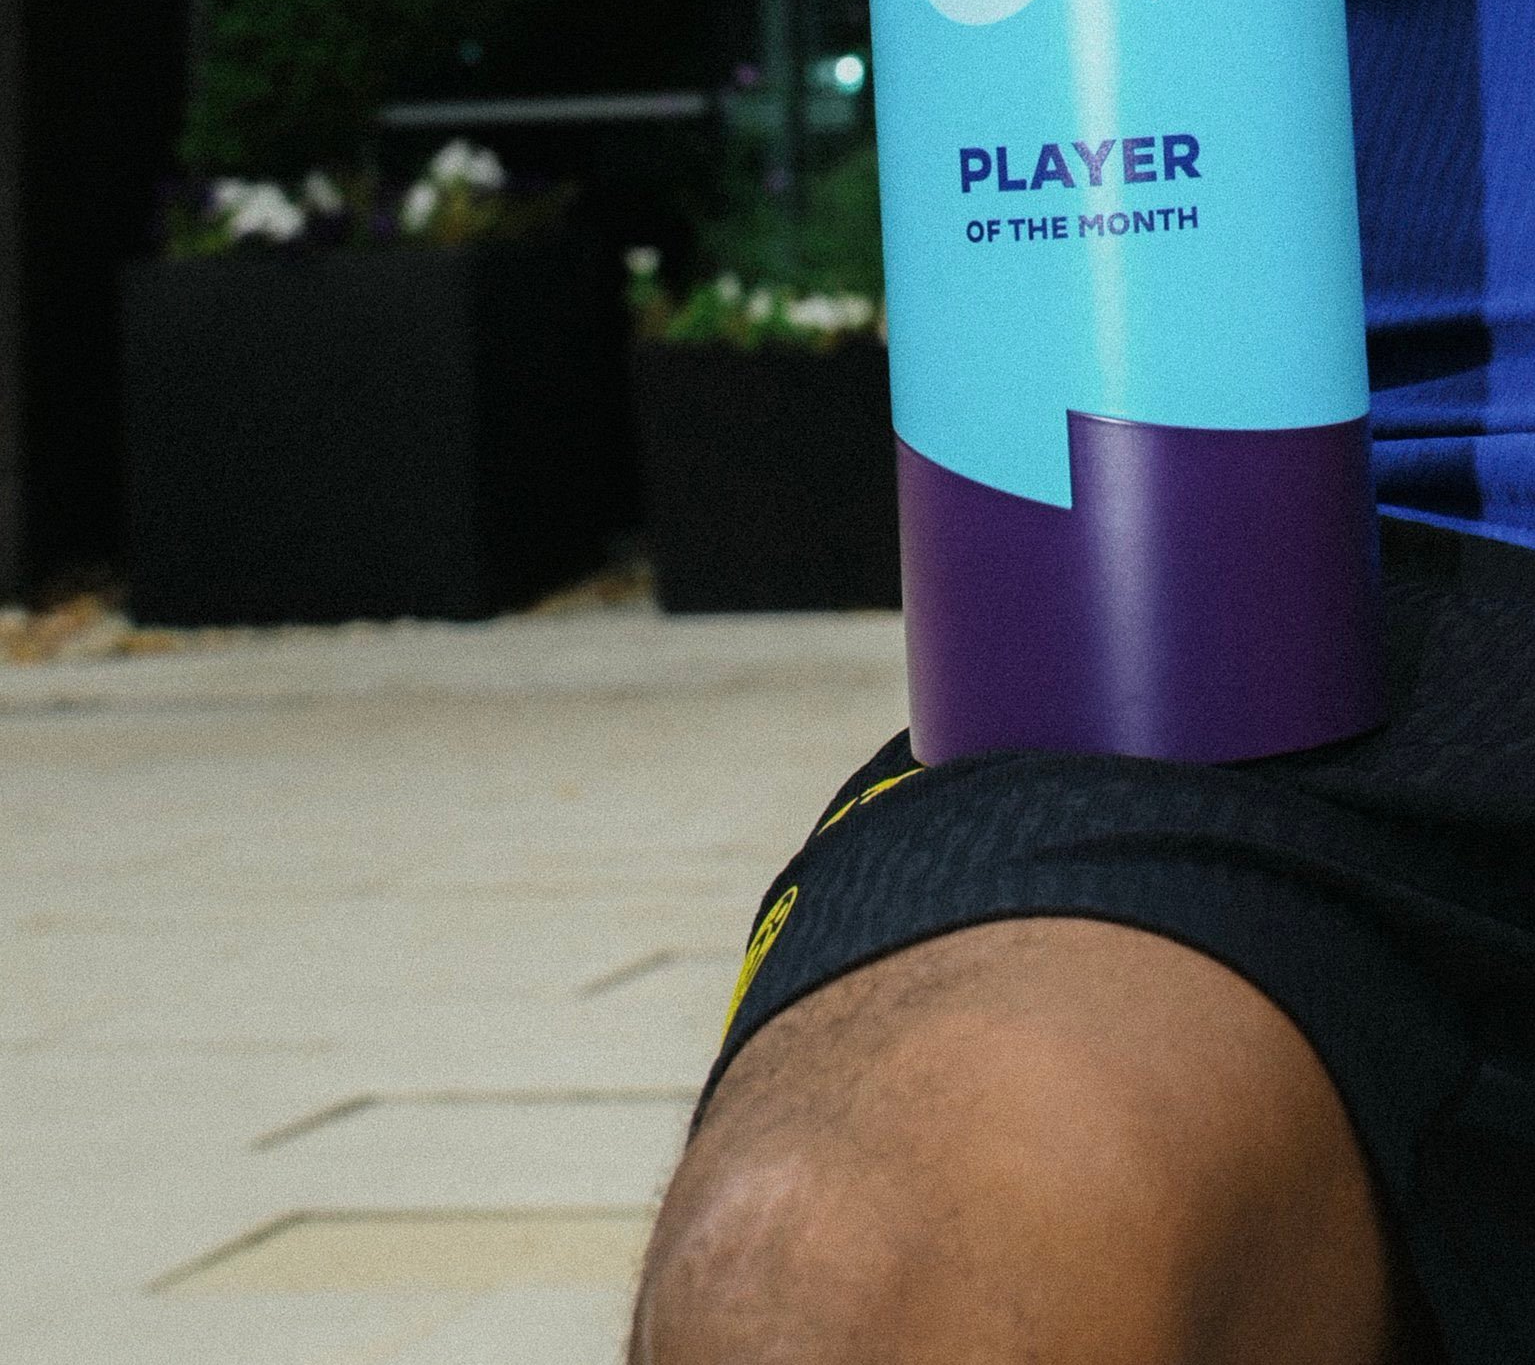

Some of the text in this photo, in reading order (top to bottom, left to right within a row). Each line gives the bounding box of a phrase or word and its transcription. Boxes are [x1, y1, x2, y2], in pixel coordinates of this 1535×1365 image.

[959, 132, 1202, 194] PLAYER
[965, 205, 1199, 244] OF THE MONTH
